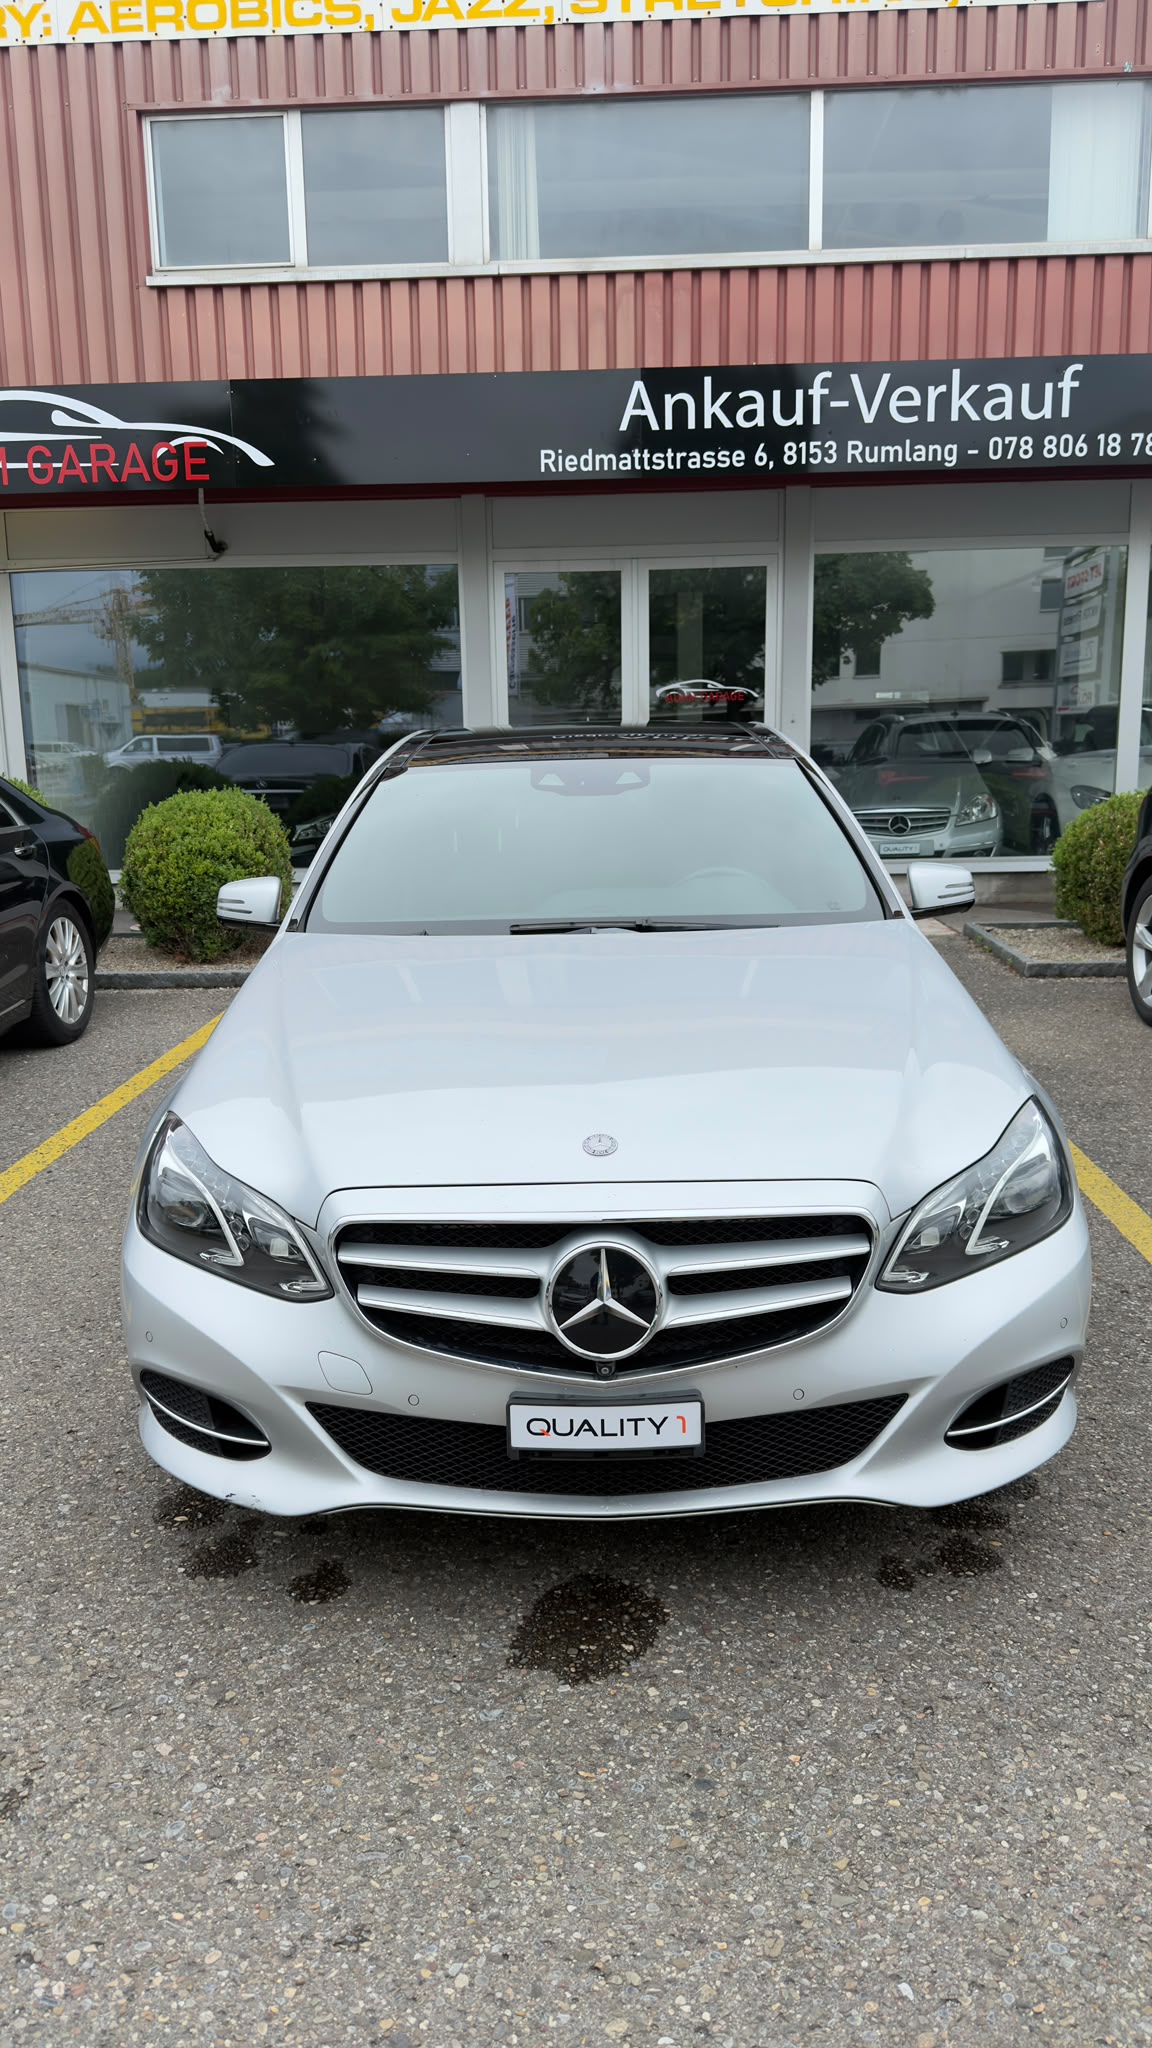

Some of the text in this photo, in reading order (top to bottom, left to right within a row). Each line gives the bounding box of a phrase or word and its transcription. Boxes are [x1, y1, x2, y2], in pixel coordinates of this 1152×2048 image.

[0, 3, 51, 38] Y:
[67, 0, 374, 35] AEROBICS,
[619, 363, 1084, 432] Ankauf-Verkauf
[26, 441, 210, 485] GARAGE
[540, 448, 746, 473] Riedmattstrasse
[754, 442, 774, 470] 6,
[783, 440, 837, 465] 8153
[847, 439, 958, 467] Rumlang
[988, 436, 1033, 460] 078
[1043, 433, 1088, 459] 806
[1097, 433, 1121, 457] 18
[701, 690, 745, 703] GARAGE
